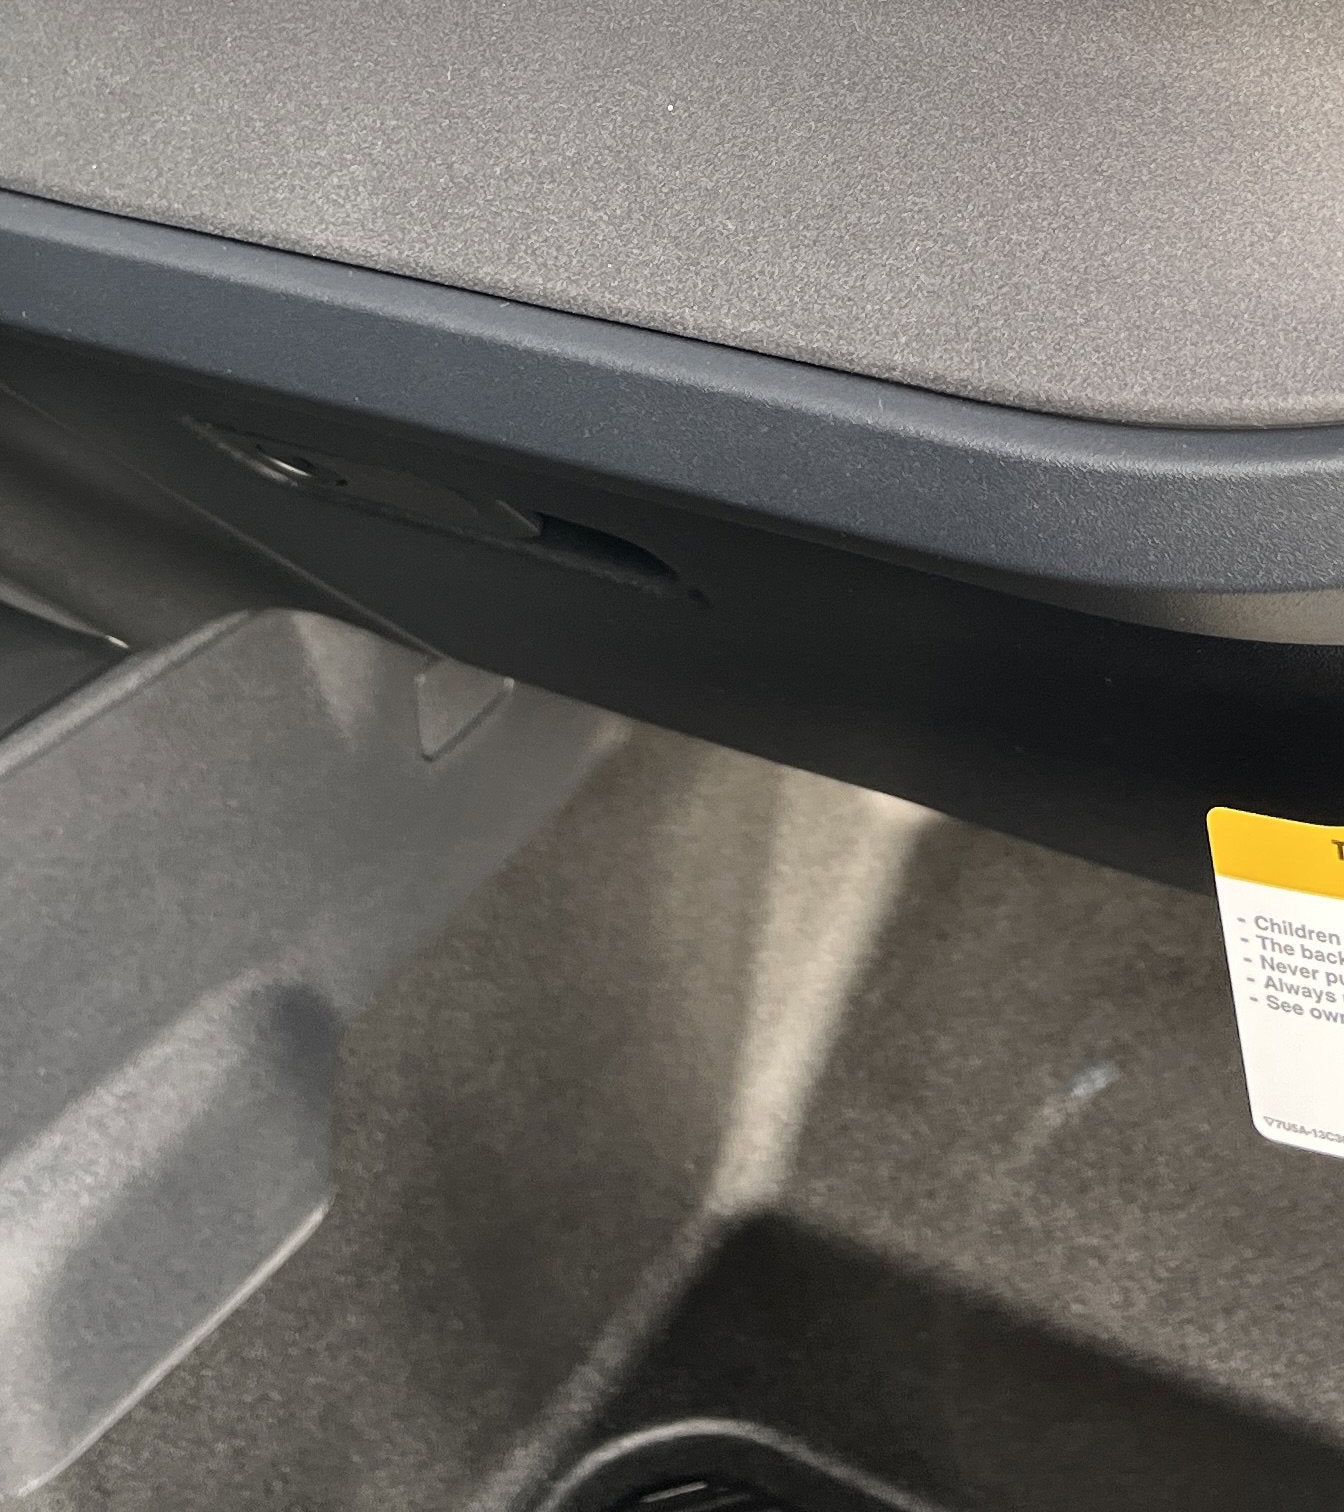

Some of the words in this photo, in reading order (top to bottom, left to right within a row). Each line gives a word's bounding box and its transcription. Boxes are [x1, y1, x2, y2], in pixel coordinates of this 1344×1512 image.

[1254, 914, 1342, 946] Children
[1256, 934, 1295, 957] The
[1259, 954, 1320, 981] Never
[1264, 974, 1338, 1005] Always
[1266, 994, 1305, 1017] See
